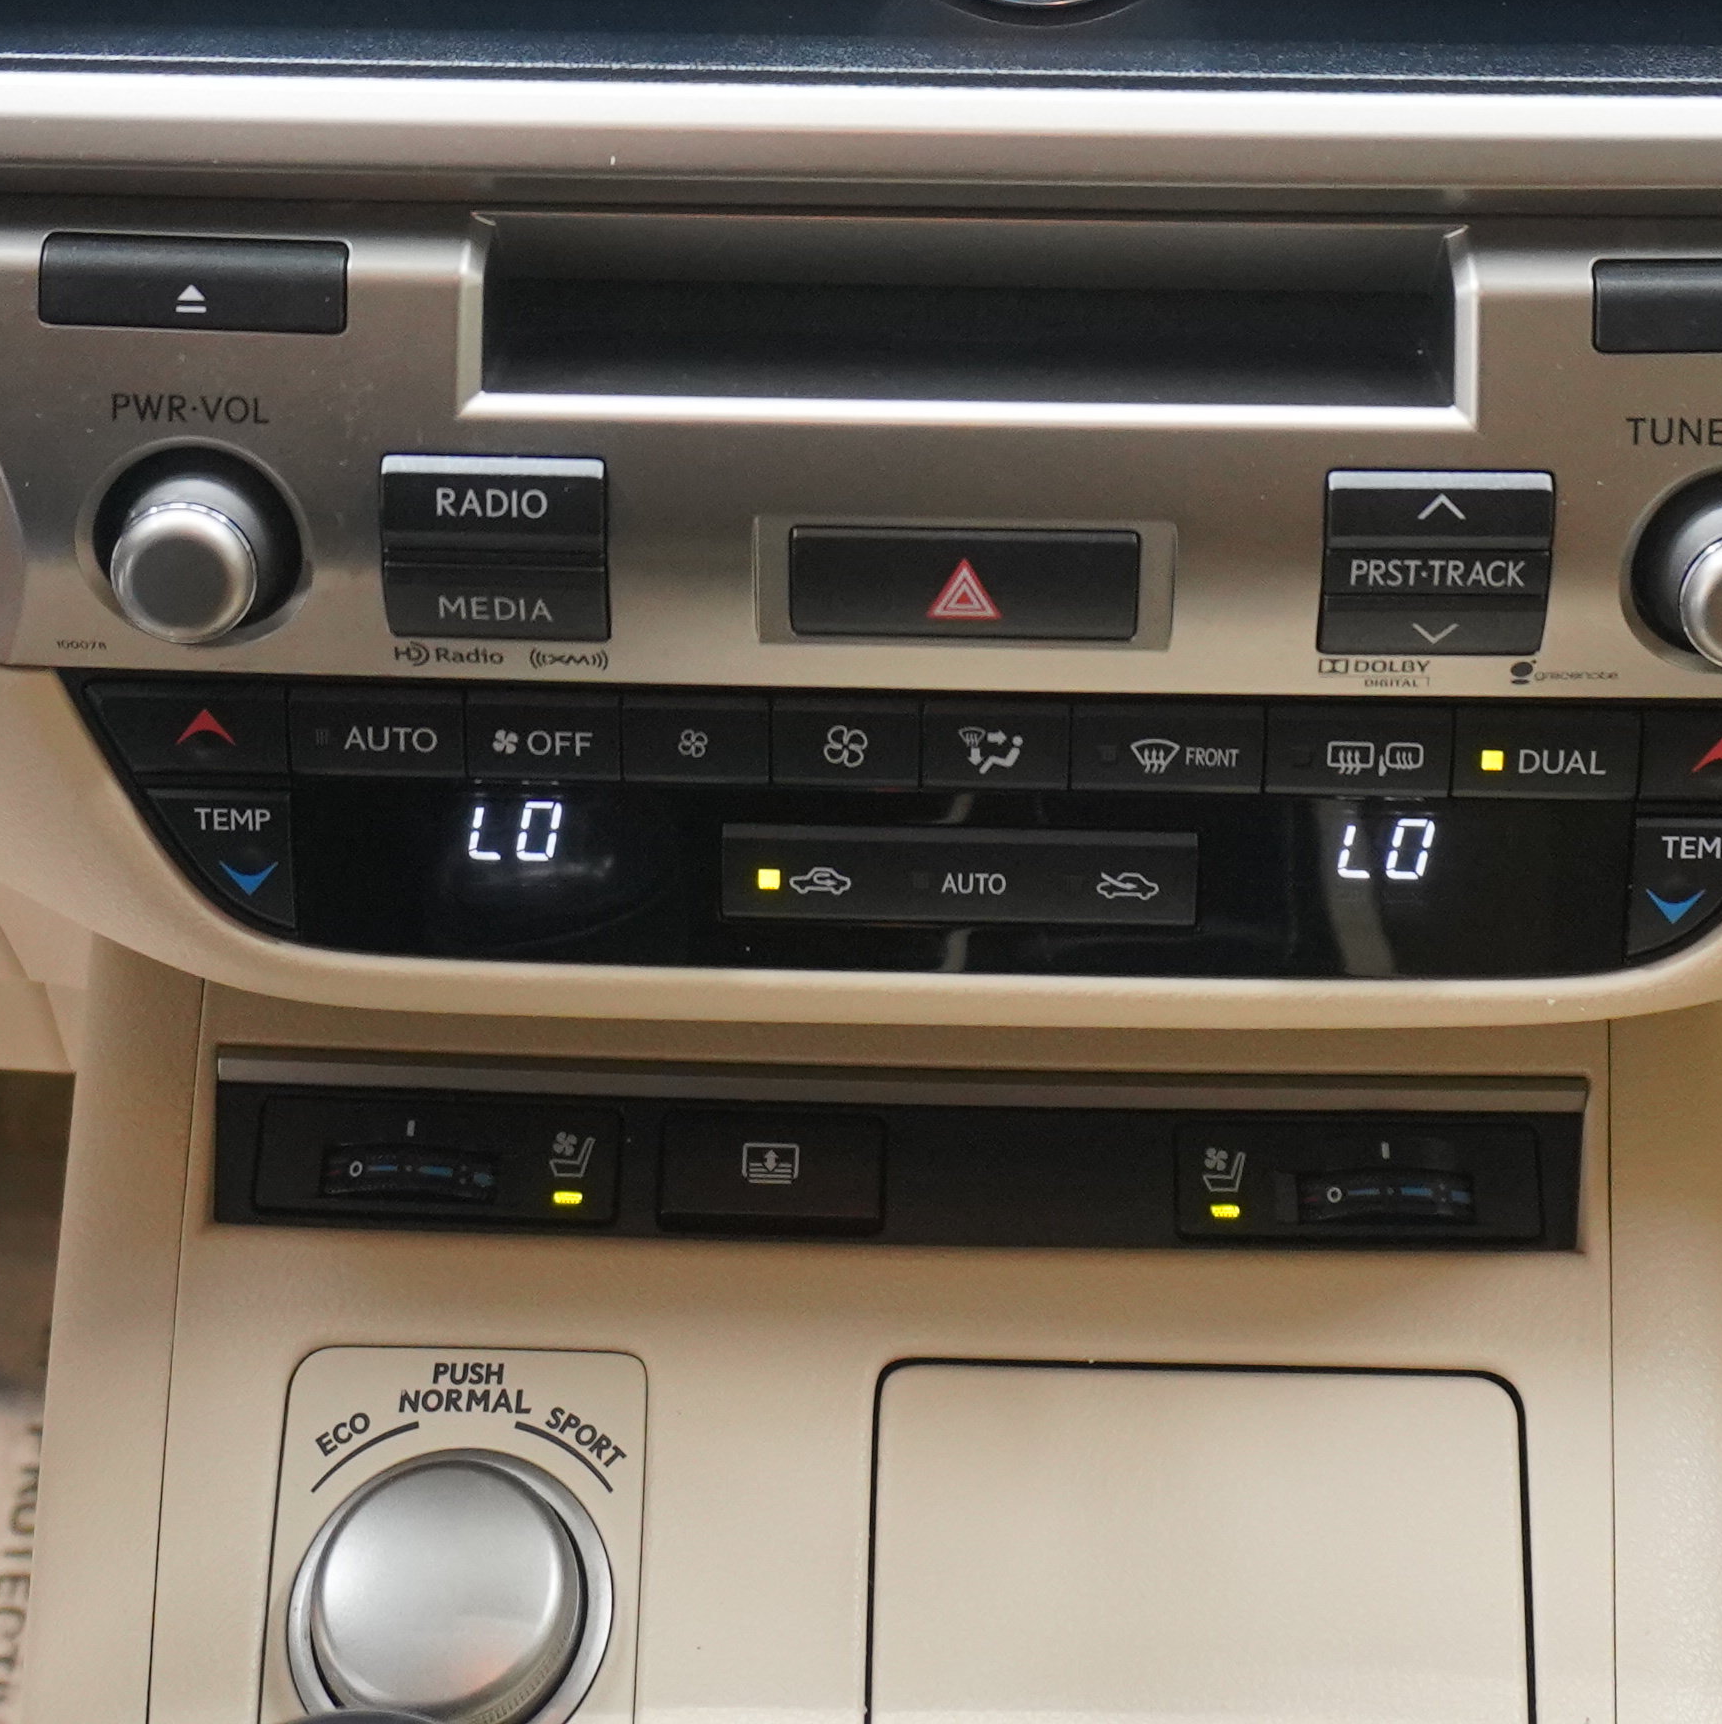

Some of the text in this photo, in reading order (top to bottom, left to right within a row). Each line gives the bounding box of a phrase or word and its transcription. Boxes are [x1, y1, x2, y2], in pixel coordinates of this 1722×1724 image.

[435, 489, 549, 519] RADIO
[437, 596, 554, 623] MEDIA
[435, 647, 505, 665] Radio
[1353, 658, 1430, 674] DOLBY
[1363, 678, 1419, 688] DIGITAL
[344, 727, 438, 754] AUTO
[527, 730, 594, 758] OFF
[1185, 746, 1240, 770] FRONT
[1517, 750, 1606, 776] DUAL
[194, 807, 271, 832] TEMP
[941, 874, 1007, 897] AUTO
[432, 1362, 504, 1385] PUSH
[398, 1388, 531, 1414] NORMAL
[315, 1412, 371, 1457] ECO
[545, 1406, 627, 1468] SPORT
